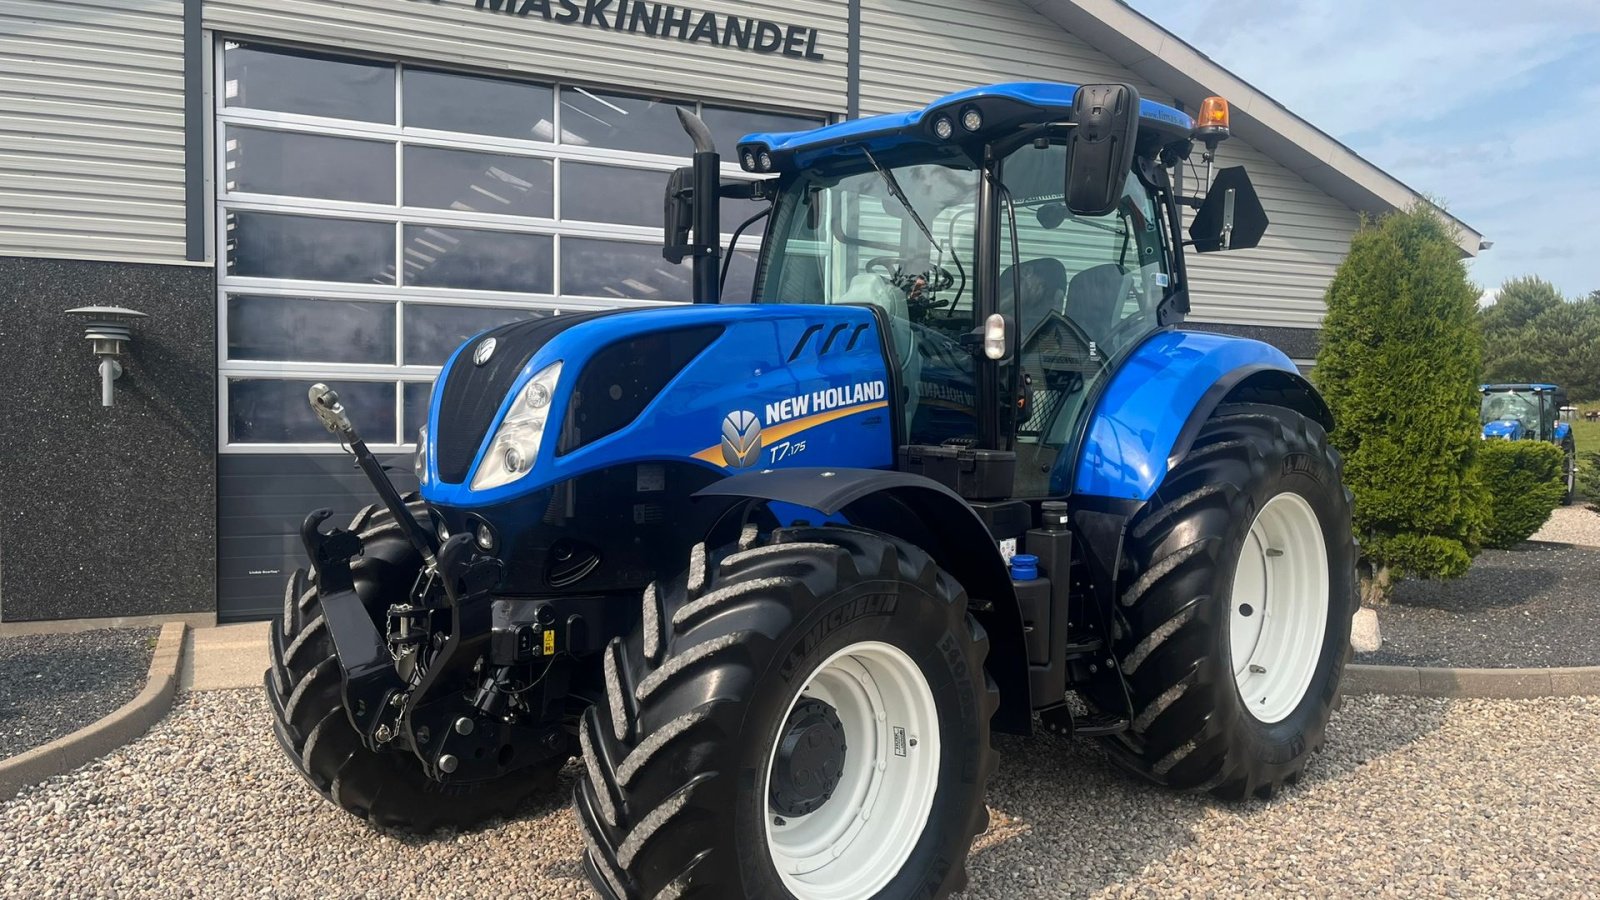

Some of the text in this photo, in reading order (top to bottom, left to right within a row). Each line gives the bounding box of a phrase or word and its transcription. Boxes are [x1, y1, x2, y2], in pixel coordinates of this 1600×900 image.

[765, 380, 885, 425] NEW HOLLAND
[770, 440, 806, 464] T7.175
[803, 594, 898, 656] MICHELIN
